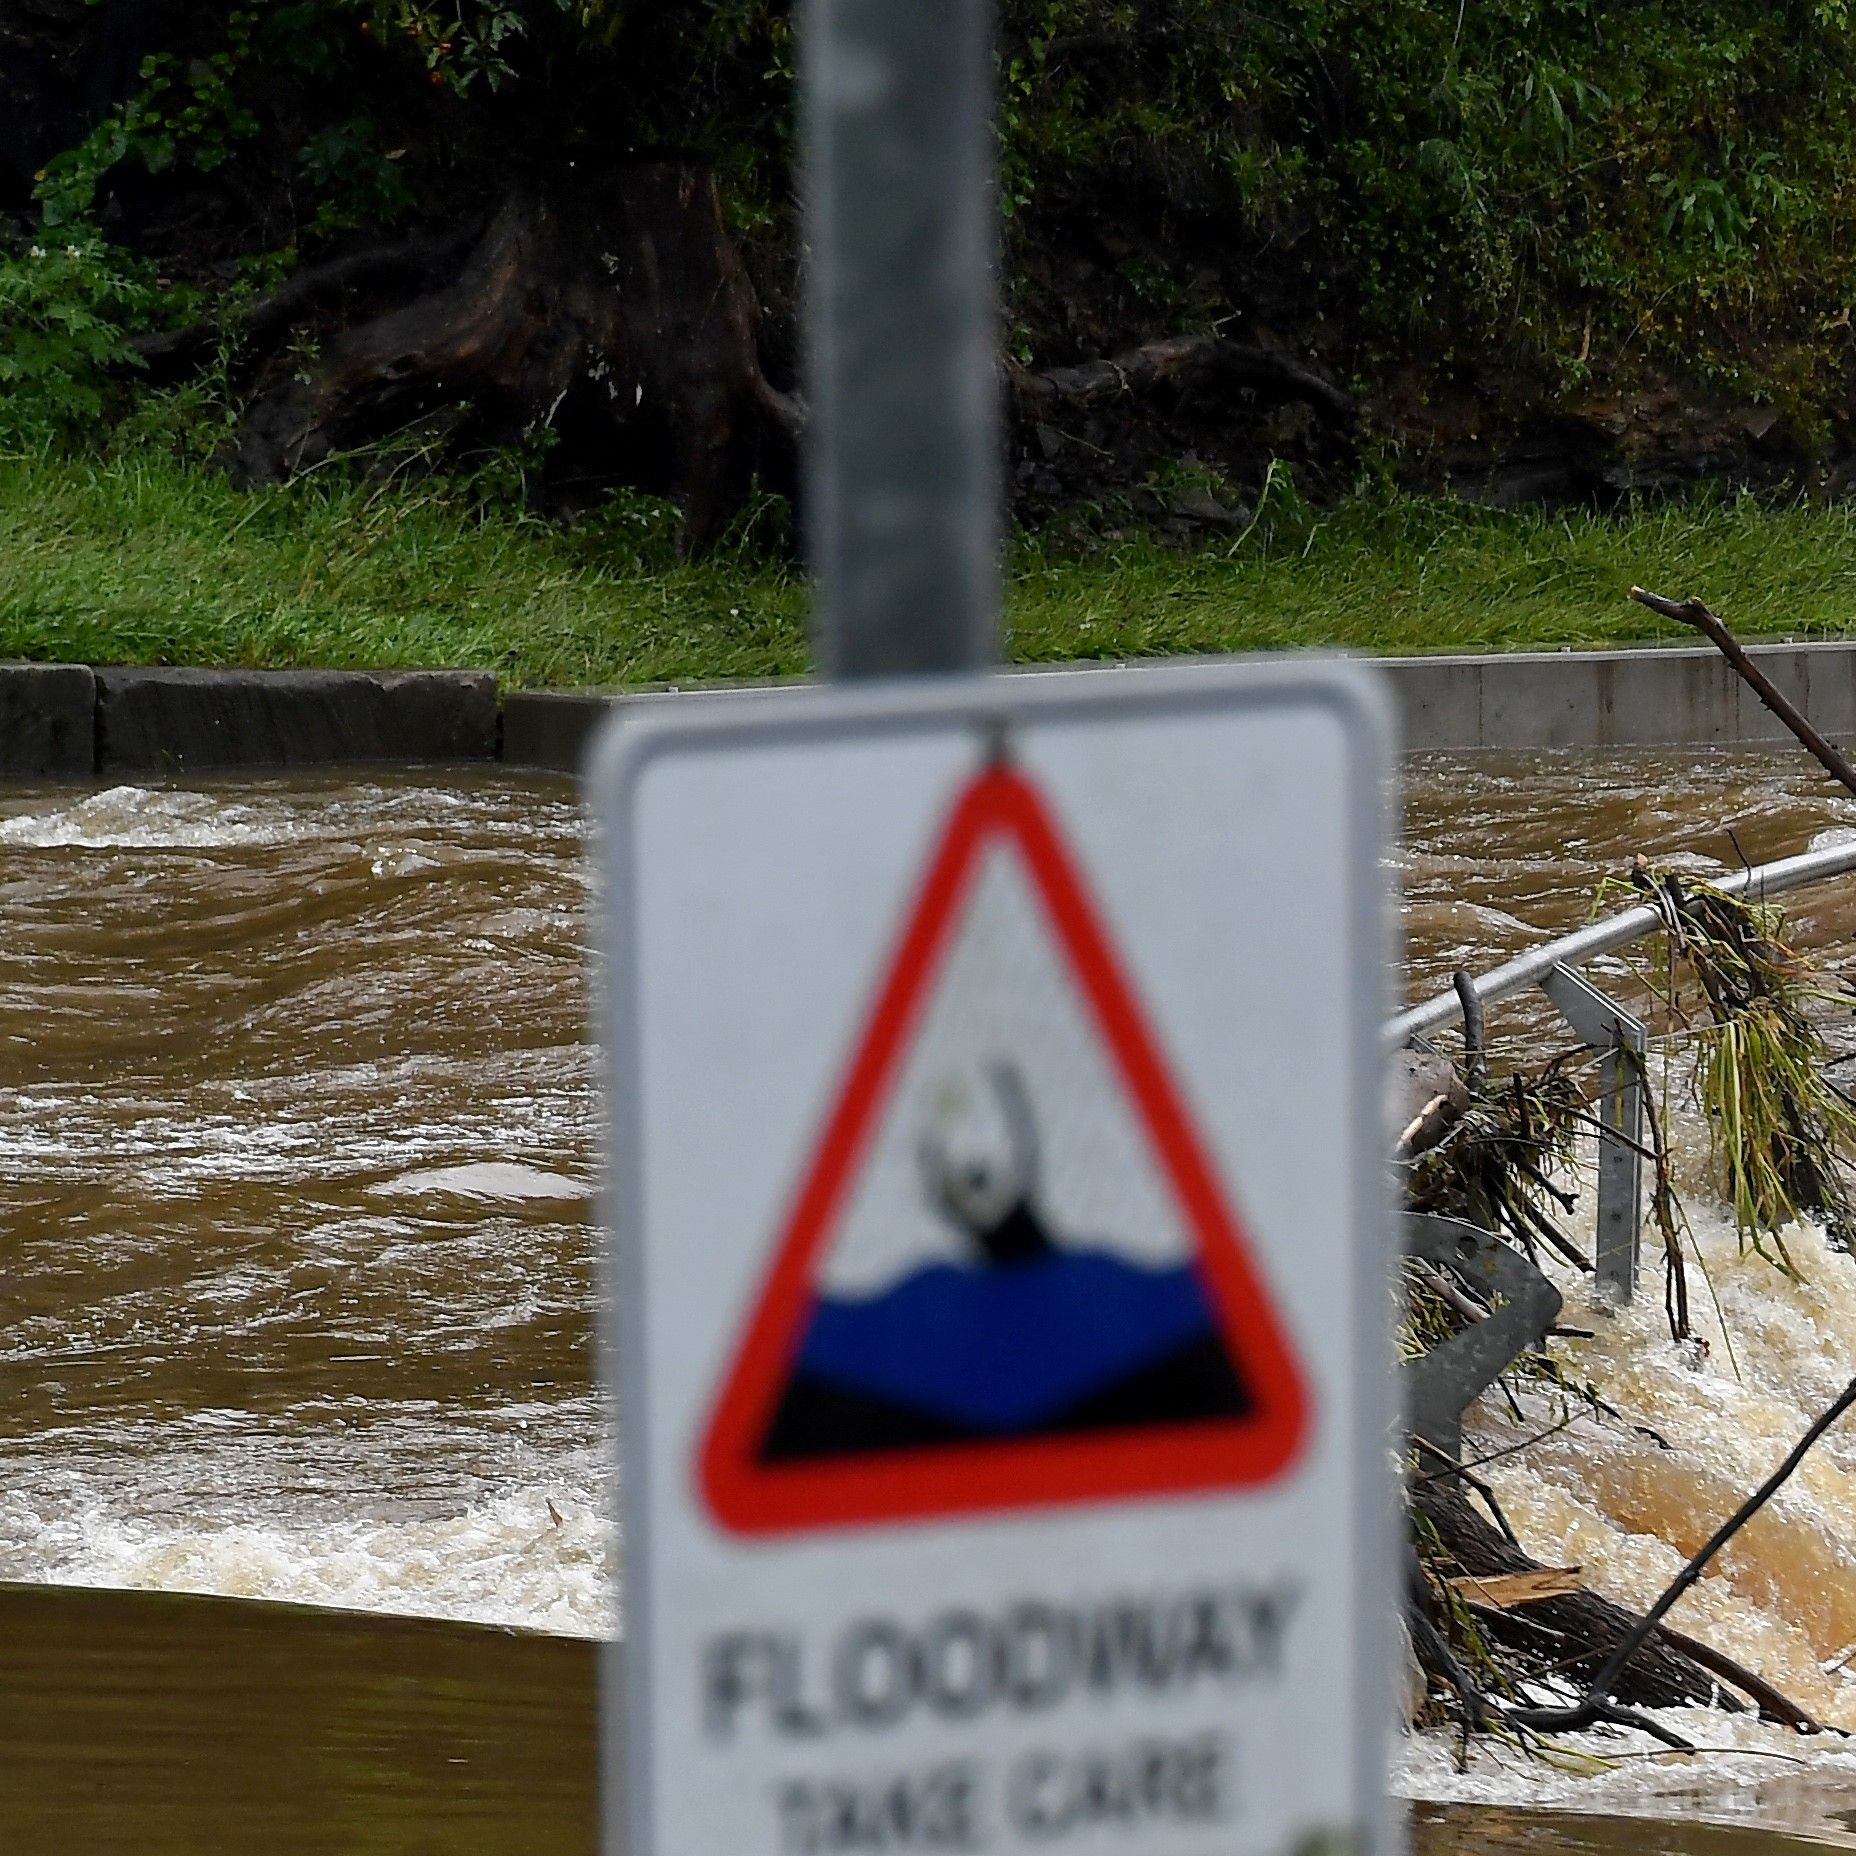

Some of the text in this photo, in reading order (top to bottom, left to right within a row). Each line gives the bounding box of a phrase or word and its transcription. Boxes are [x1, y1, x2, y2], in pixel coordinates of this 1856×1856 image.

[703, 1593, 1294, 1738] FLOODWAY
[778, 1739, 1221, 1855] TAKE CARE
